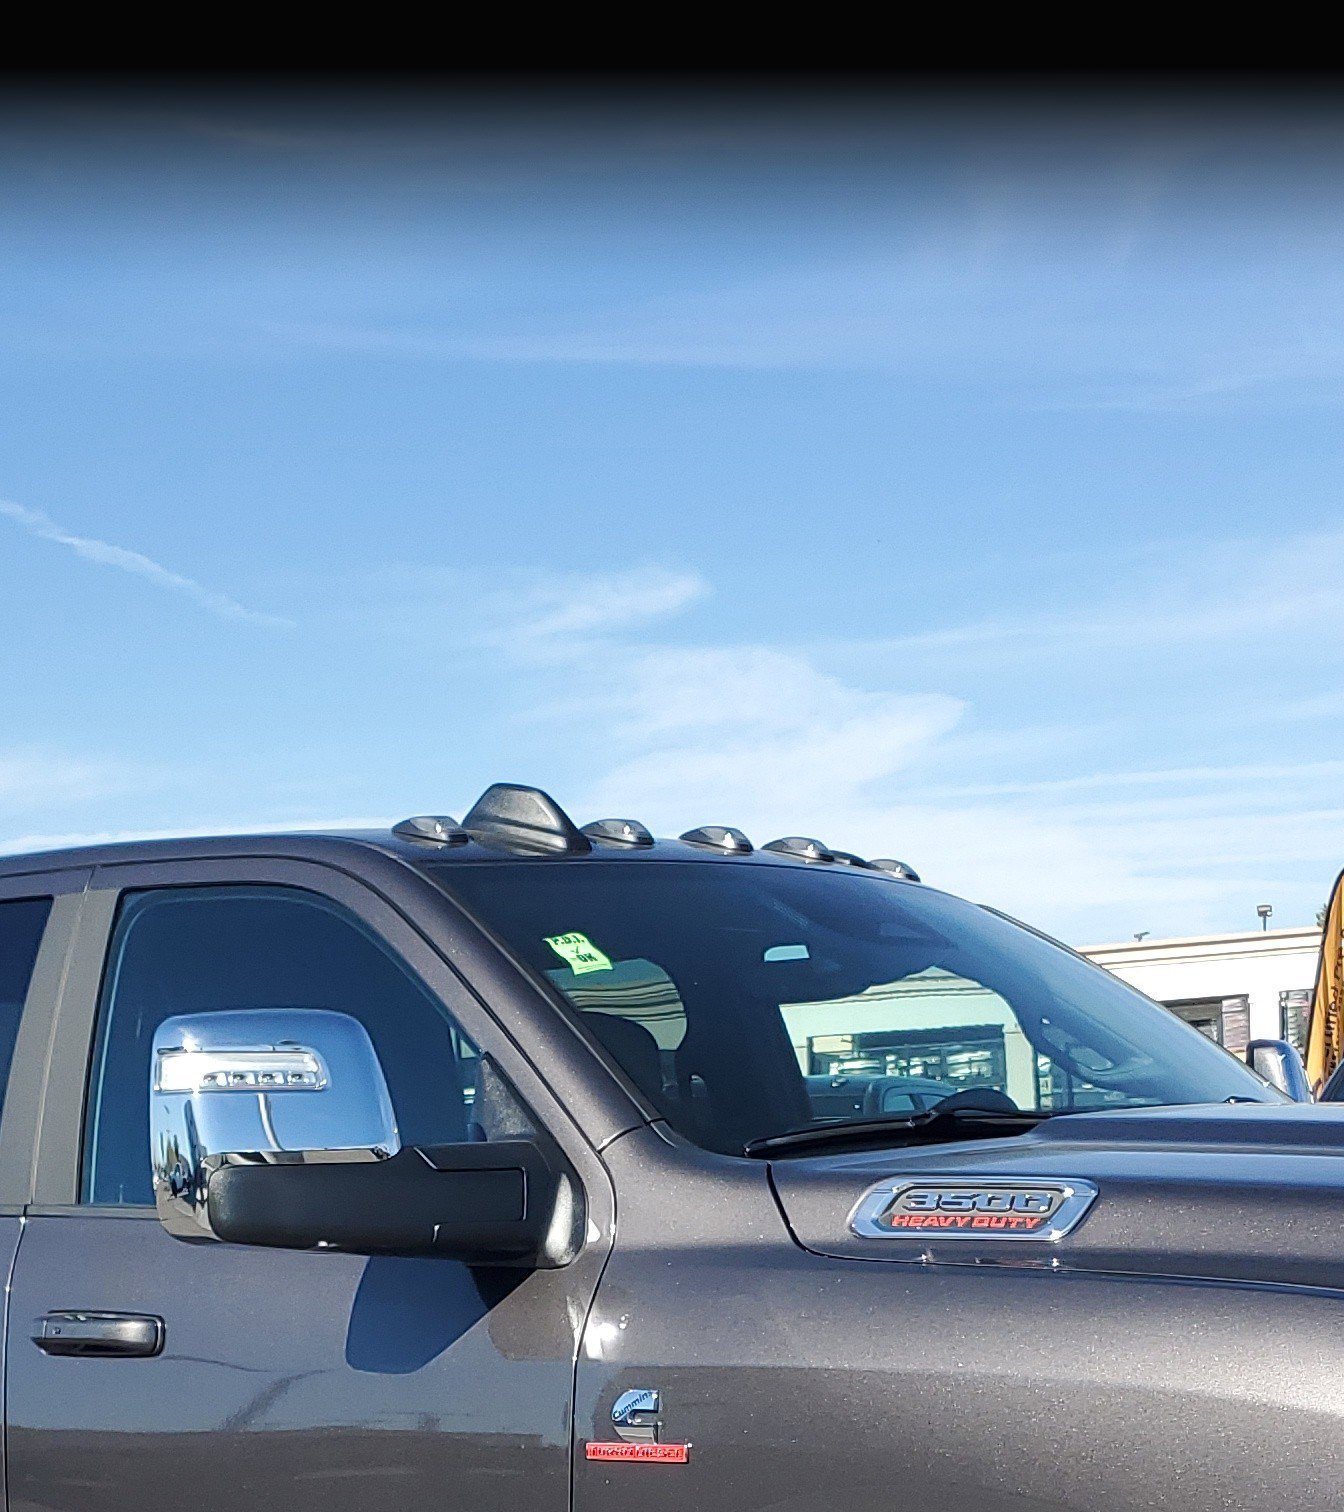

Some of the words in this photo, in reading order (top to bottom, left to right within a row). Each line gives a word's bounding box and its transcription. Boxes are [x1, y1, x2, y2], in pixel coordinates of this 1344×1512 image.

[902, 1193, 1053, 1213] 3500
[892, 1215, 971, 1228] HEAVY
[972, 1216, 1041, 1229] DUTY
